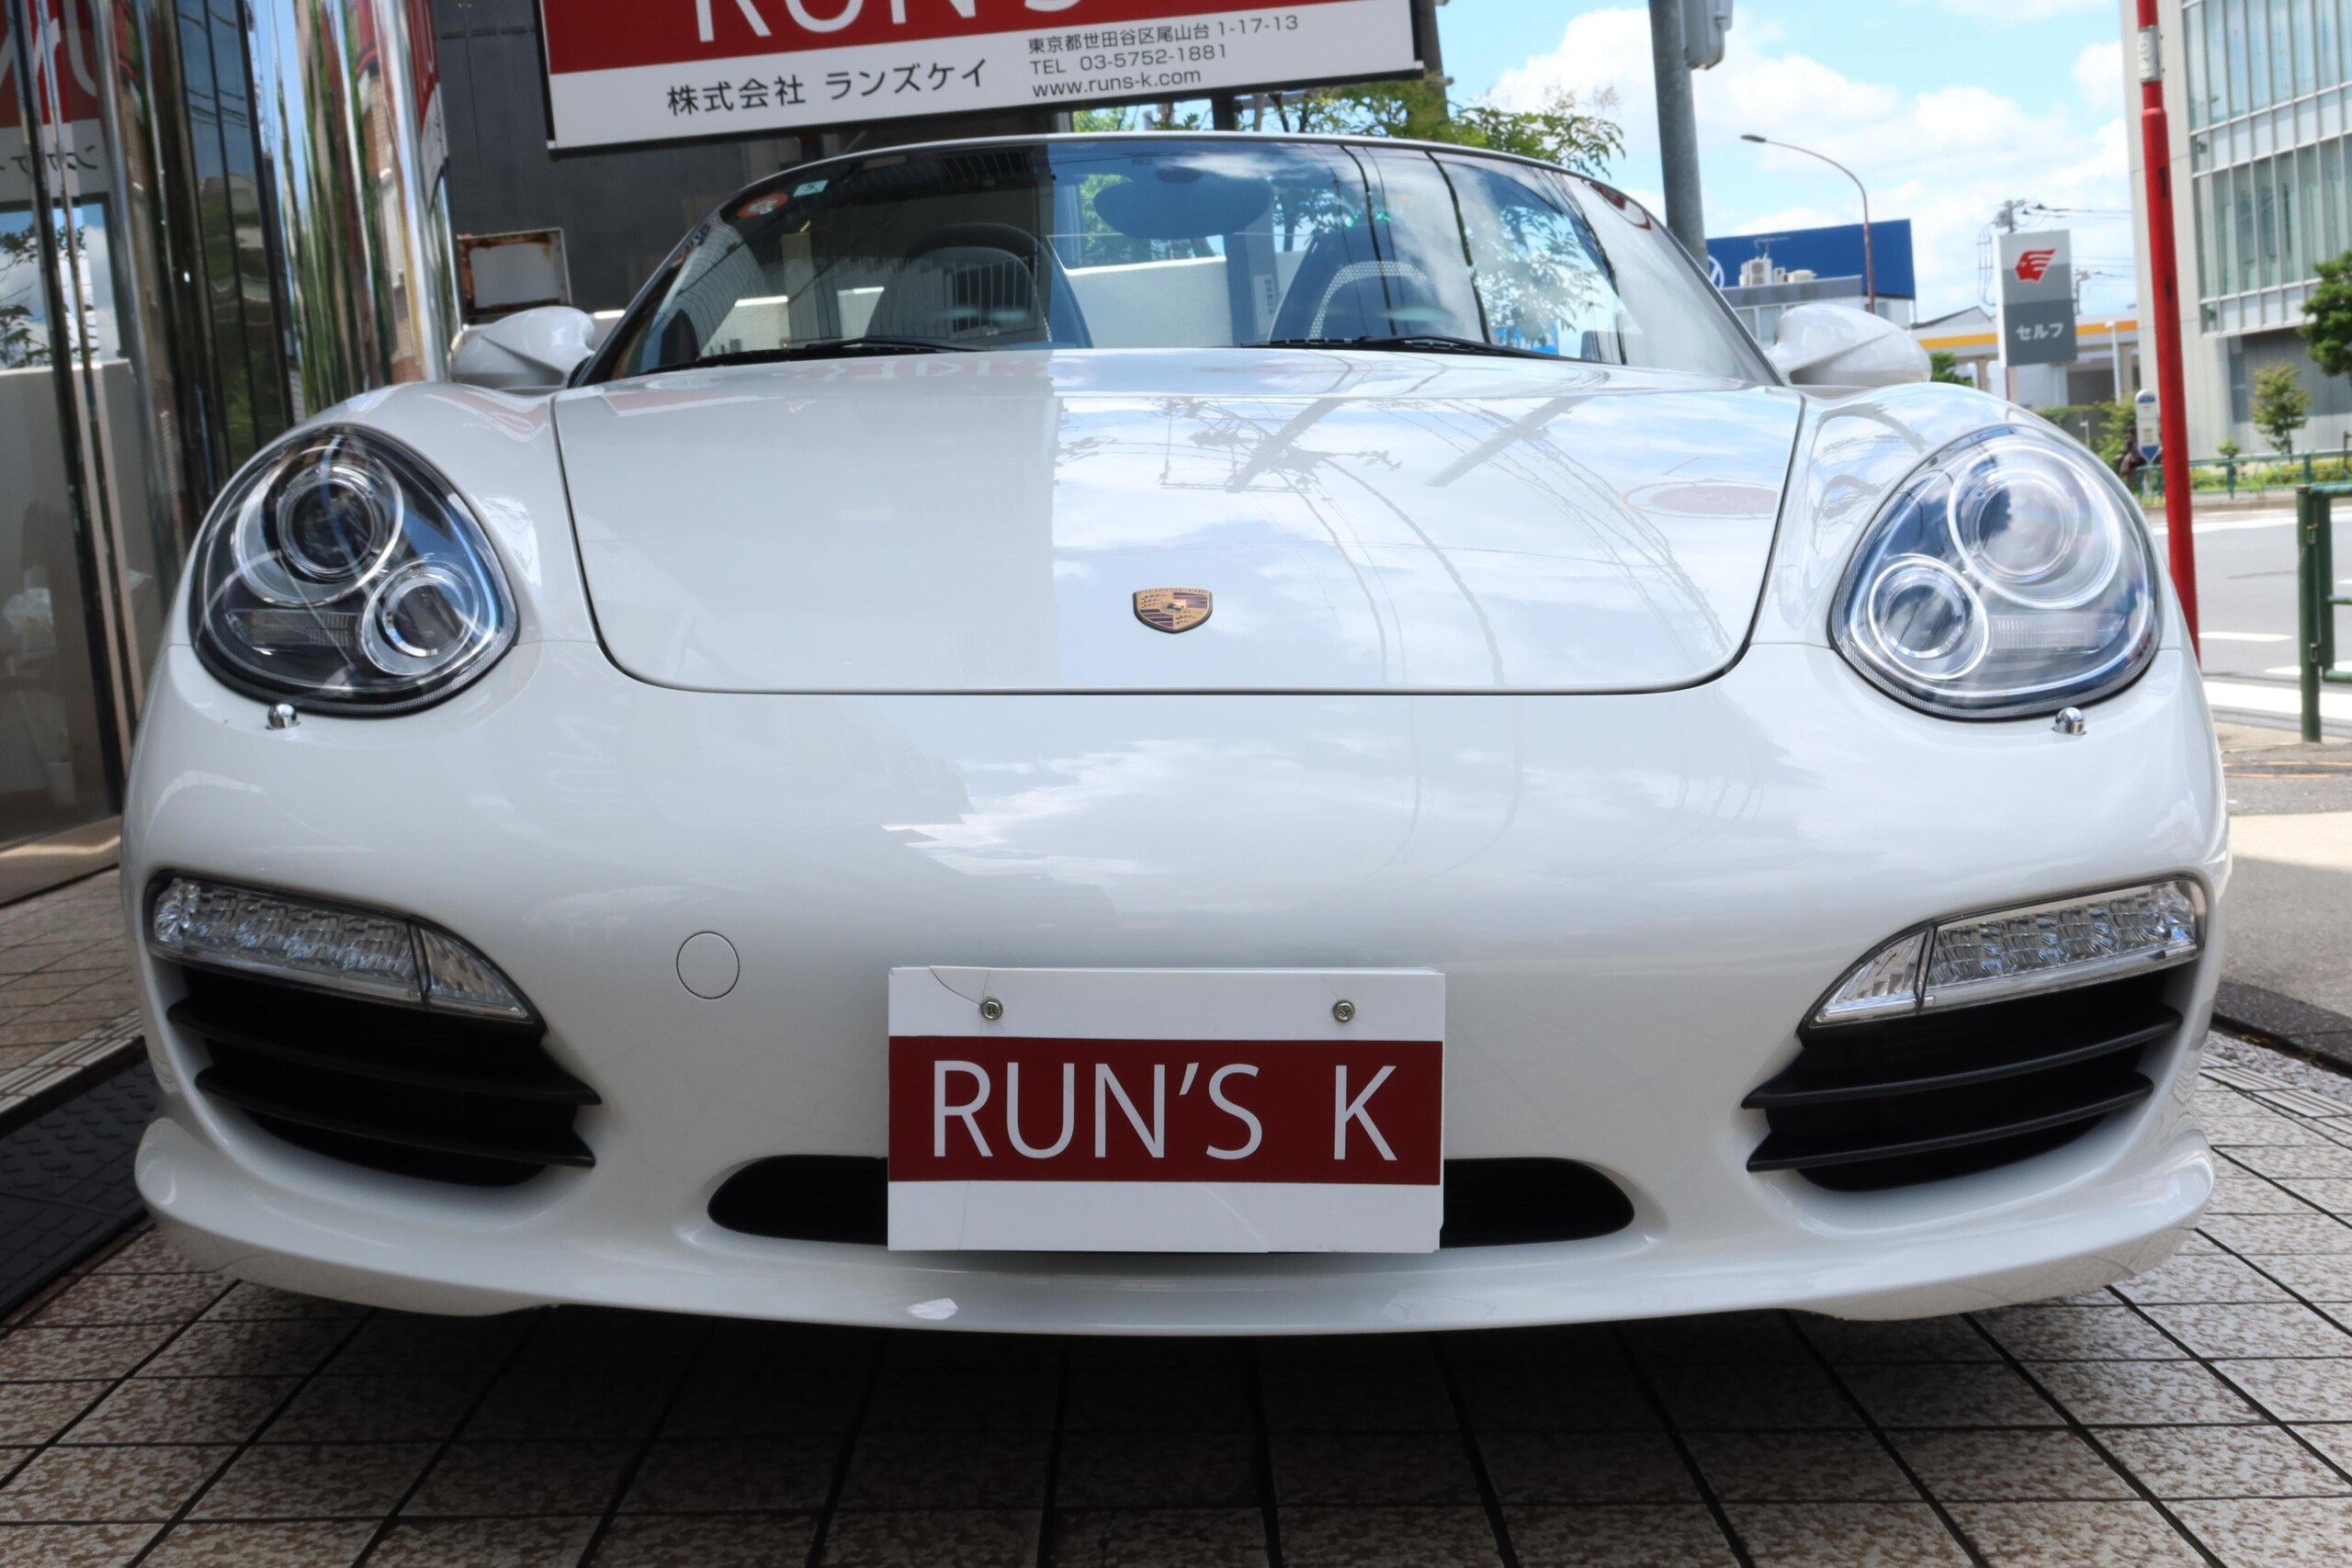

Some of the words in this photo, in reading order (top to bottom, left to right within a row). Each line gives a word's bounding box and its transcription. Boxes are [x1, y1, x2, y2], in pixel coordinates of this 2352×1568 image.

[1028, 22, 1209, 55] 東京都世田谷区尾山台
[1217, 15, 1299, 37] 1-17-13
[1029, 59, 1067, 75] TEL
[1080, 43, 1227, 72] 03-5752-1881
[667, 74, 806, 117] 株式会社
[825, 58, 988, 101] ランズケイ
[1032, 70, 1201, 97] www.runs-k.com
[2016, 322, 2064, 341] セルフ
[1333, 1065, 1398, 1161] K
